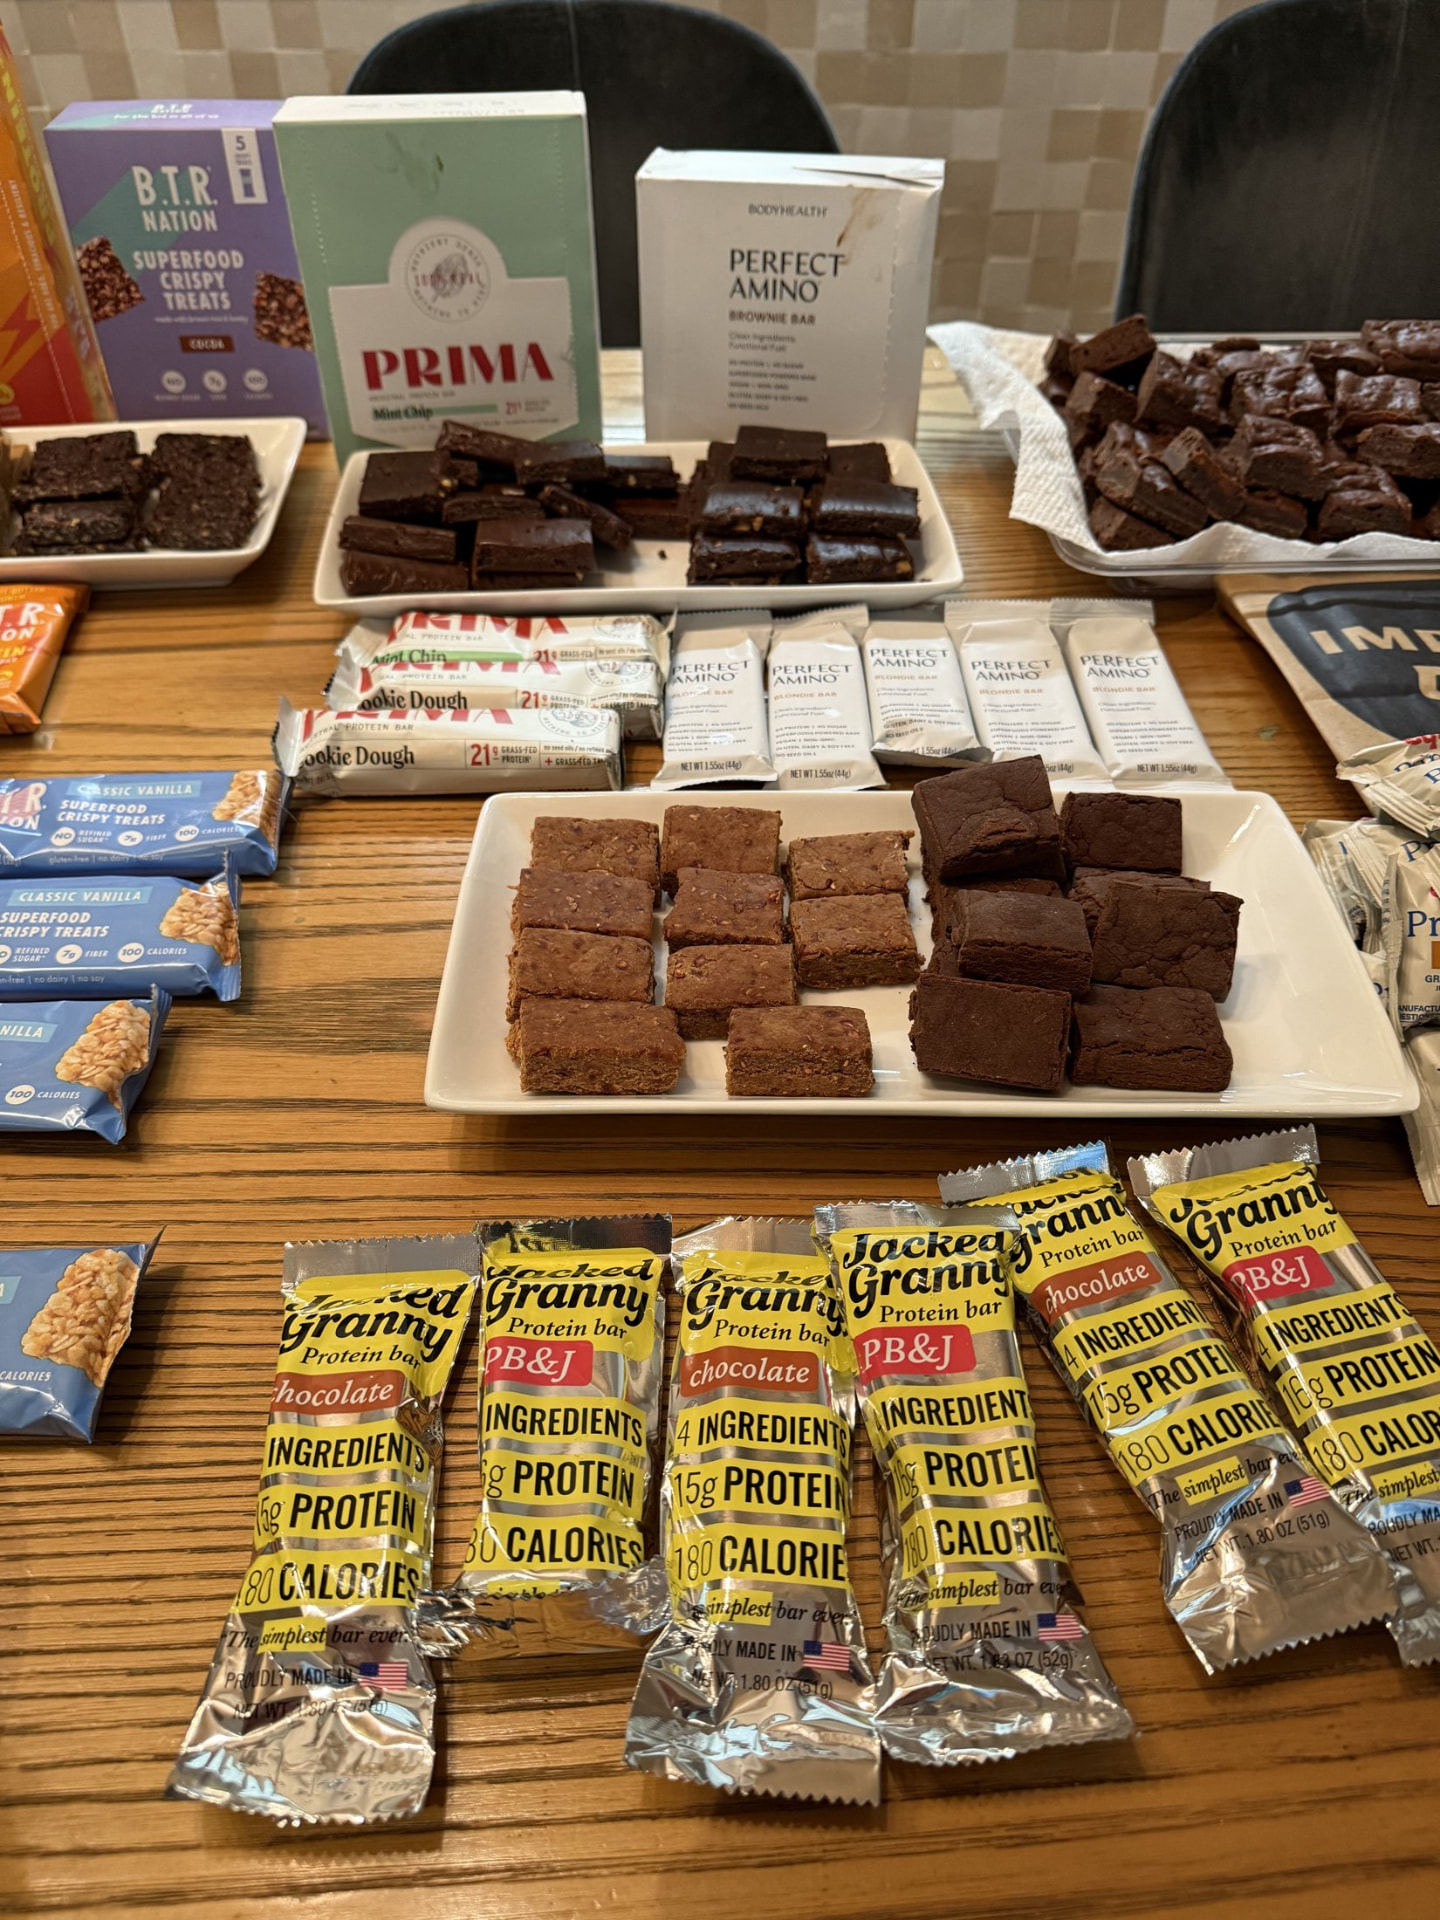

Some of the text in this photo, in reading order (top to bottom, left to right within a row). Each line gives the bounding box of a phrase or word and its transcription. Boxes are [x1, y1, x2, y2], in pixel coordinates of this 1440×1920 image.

[235, 135, 246, 151] 5
[142, 209, 218, 232] NATION
[748, 203, 827, 218] BODYHEALTH
[133, 250, 244, 269] SUPERFOOD
[730, 248, 846, 277] PERFECT
[160, 271, 225, 290] CRISPY
[729, 277, 819, 303] AMINO
[163, 292, 231, 310] TREATS
[729, 310, 816, 326] BROWNIE BAR
[361, 342, 554, 391] PRIMA
[373, 406, 400, 420] Mint
[403, 404, 433, 420] Chip
[870, 648, 949, 658] PERFECT
[872, 658, 937, 667] AMINO
[971, 659, 1051, 670] PERFECT
[1080, 654, 1159, 667] PERFECT
[672, 660, 751, 676] PERFECT
[672, 672, 736, 685] AMINO
[772, 664, 853, 676] PERFECT
[773, 673, 838, 687] AMINO
[975, 670, 1041, 681] AMINO
[1087, 667, 1150, 678] AMINO
[358, 686, 406, 710] ookie
[346, 722, 414, 731] PROTEIN BAR
[356, 745, 415, 769] Dough
[501, 745, 538, 754] GRASS-FED
[138, 784, 192, 796] VANILLA
[57, 811, 165, 826] CRISPY TREATS
[60, 799, 147, 814] SUPERFOOD
[54, 832, 72, 840] NO
[179, 829, 198, 837] 100
[19, 891, 141, 902] CLASSIC VANILLA
[1, 912, 91, 924] SUPERFOOD
[54, 926, 110, 938] TREATS
[15, 947, 50, 955] REFINED
[121, 946, 188, 956] 100 CALORIES
[9, 1089, 81, 1099] 100 CALORIES
[1186, 1180, 1338, 1261] Granny
[1039, 1229, 1145, 1269] Protein bar
[1229, 1218, 1338, 1258] Protein bar
[486, 1258, 655, 1282] Jacked
[849, 1258, 1010, 1319] Granny
[1045, 1263, 1150, 1315] chocolate
[485, 1276, 648, 1327] Granny
[879, 1299, 1002, 1323] Protein bar
[507, 1316, 628, 1339] Protein bar
[713, 1319, 831, 1348] Protein bar
[1264, 1292, 1413, 1352] INGREDIENTS
[279, 1309, 453, 1363] Granny
[299, 1344, 421, 1371] Protein bar
[485, 1345, 576, 1383] PB&J
[862, 1332, 953, 1373] PB&J
[1063, 1343, 1080, 1370] 4
[689, 1356, 810, 1388] chocolate
[1322, 1338, 1440, 1397] PROTEIN
[1089, 1380, 1140, 1420] 15g
[485, 1402, 643, 1448] INGREDIENTS
[676, 1409, 847, 1458] 4 INGREDIENTS
[1117, 1397, 1281, 1480] 180 CALORIE
[267, 1432, 425, 1473] INGREDIENTS
[1311, 1430, 1365, 1478] 180
[513, 1459, 635, 1508] PROTEIN
[673, 1465, 847, 1513] 15g PROTEIN
[1183, 1457, 1273, 1498] simplest bar
[1378, 1468, 1440, 1498] simplest
[289, 1489, 415, 1533] PROTEIN
[1229, 1490, 1284, 1523] MADE IN
[1217, 1509, 1331, 1554] WT. 1.80 OZ (51g)
[507, 1526, 642, 1569] CALORIES
[673, 1534, 847, 1582] 180 CALORIE
[904, 1524, 928, 1573] 180
[279, 1561, 419, 1604] CALORIES
[929, 1577, 1035, 1605] simplest bar
[706, 1596, 774, 1623] simplest
[776, 1600, 808, 1622] bar
[259, 1624, 366, 1650] simplest bar
[970, 1619, 1031, 1640] MADE IN
[736, 1640, 777, 1661] MADE
[781, 1643, 797, 1662] IN
[949, 1651, 1074, 1671] WT. OZ (52g)
[224, 1666, 353, 1689] PROUDLY MADE IN
[740, 1674, 834, 1700] 1.80 OZ (51g)
